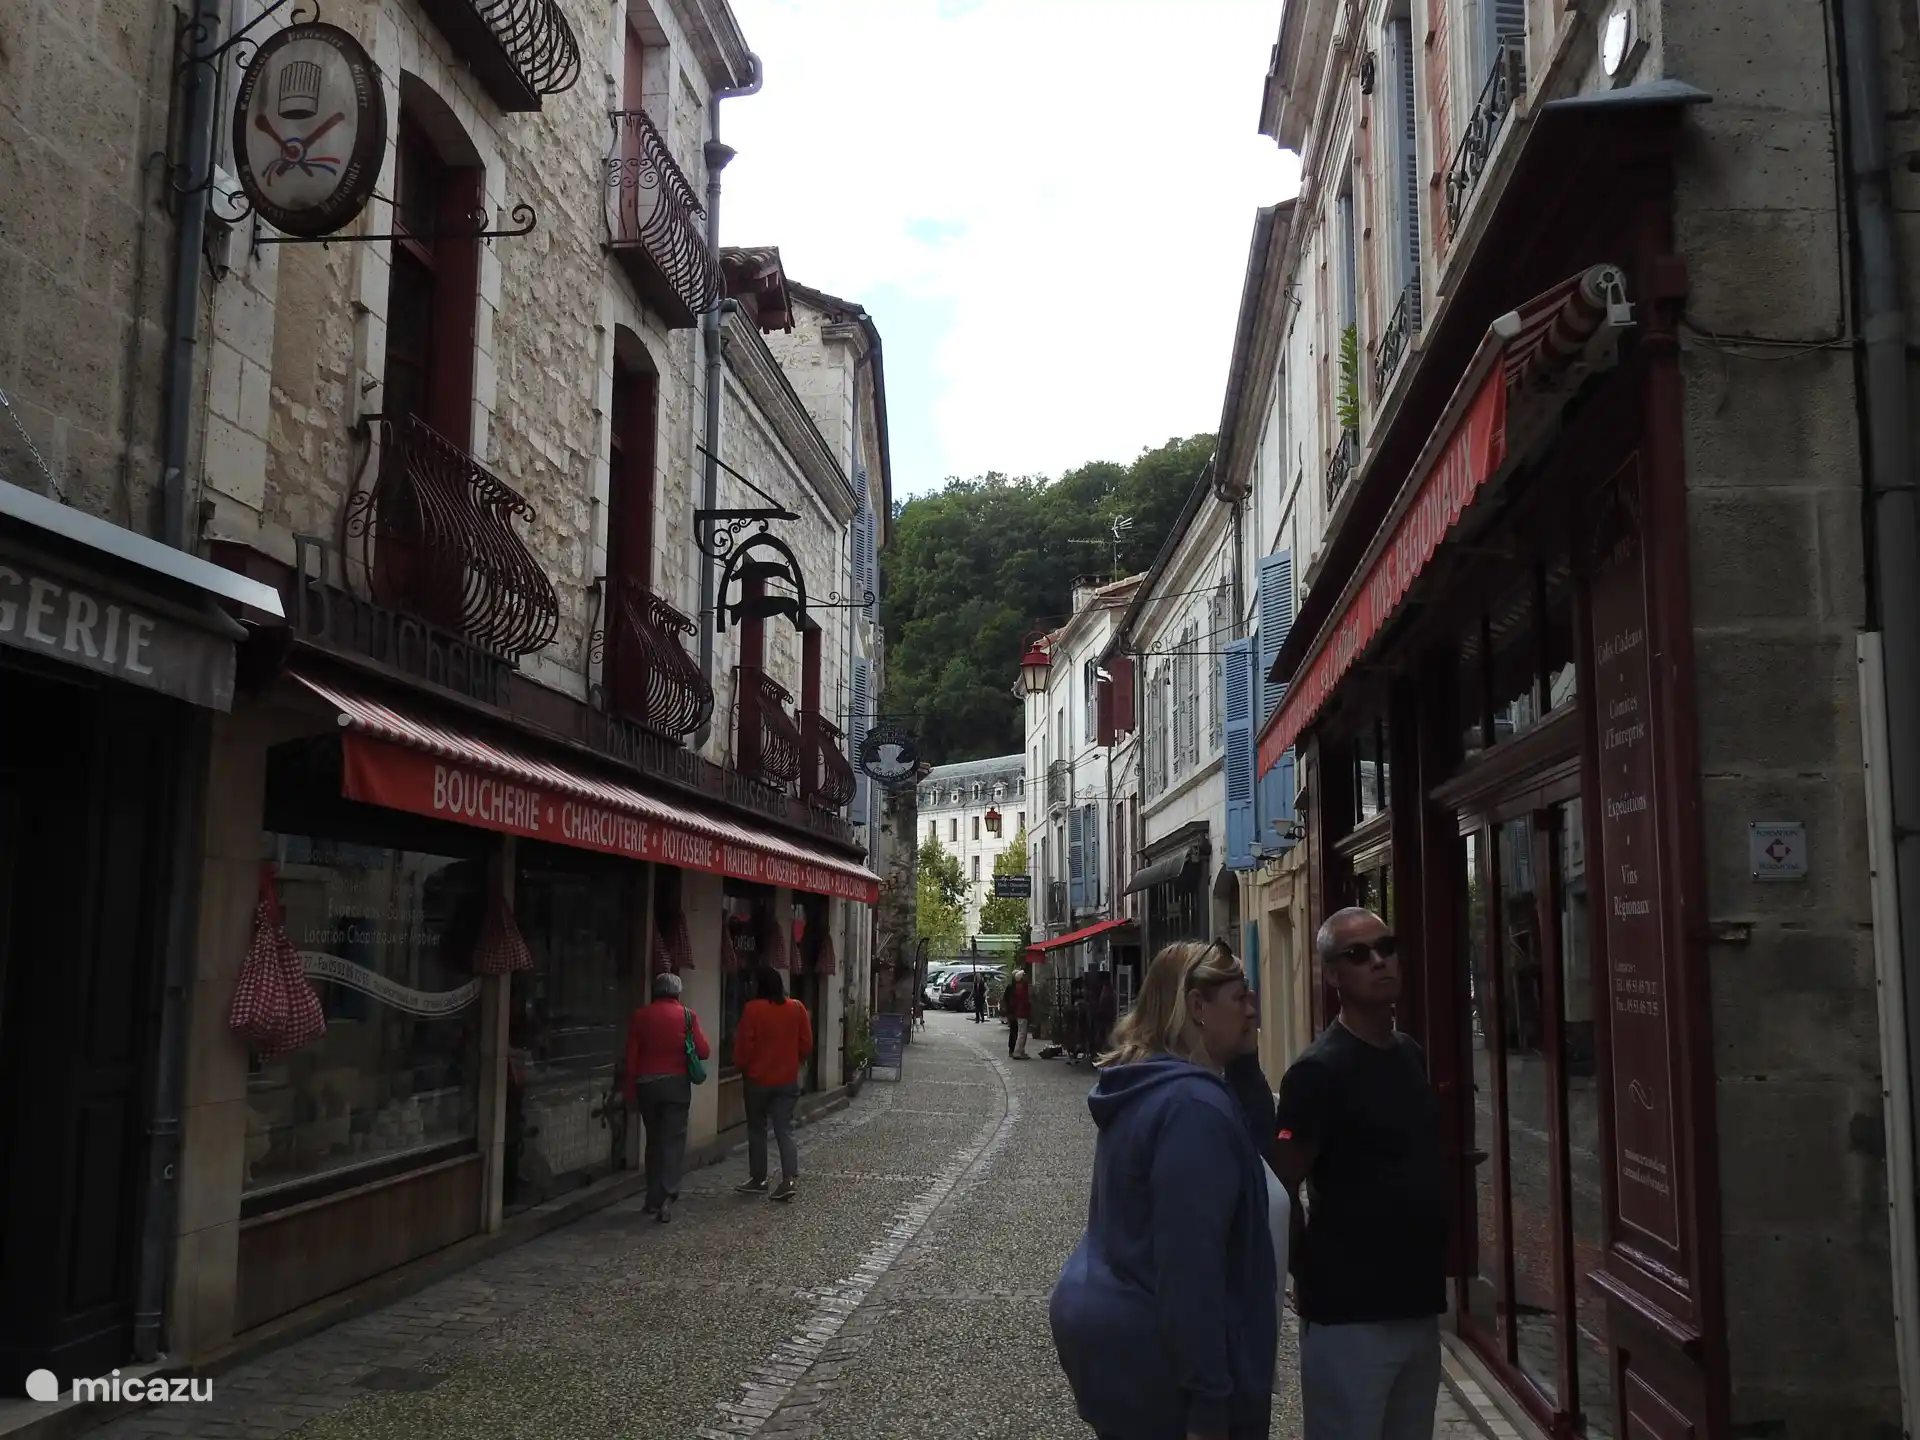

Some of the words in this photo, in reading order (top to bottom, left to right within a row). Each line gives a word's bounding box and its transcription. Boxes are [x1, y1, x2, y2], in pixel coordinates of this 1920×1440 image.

[1614, 627, 1642, 655] Cadeaux
[433, 765, 540, 831] BOUCHERIE
[561, 801, 649, 854] CHARCUTERIE
[723, 845, 758, 877] TRAITEUR
[766, 856, 800, 886] CONSERVES
[1621, 864, 1638, 885] Vins
[1614, 894, 1650, 922] Régionaux
[304, 923, 344, 944] Location
[399, 931, 408, 945] et
